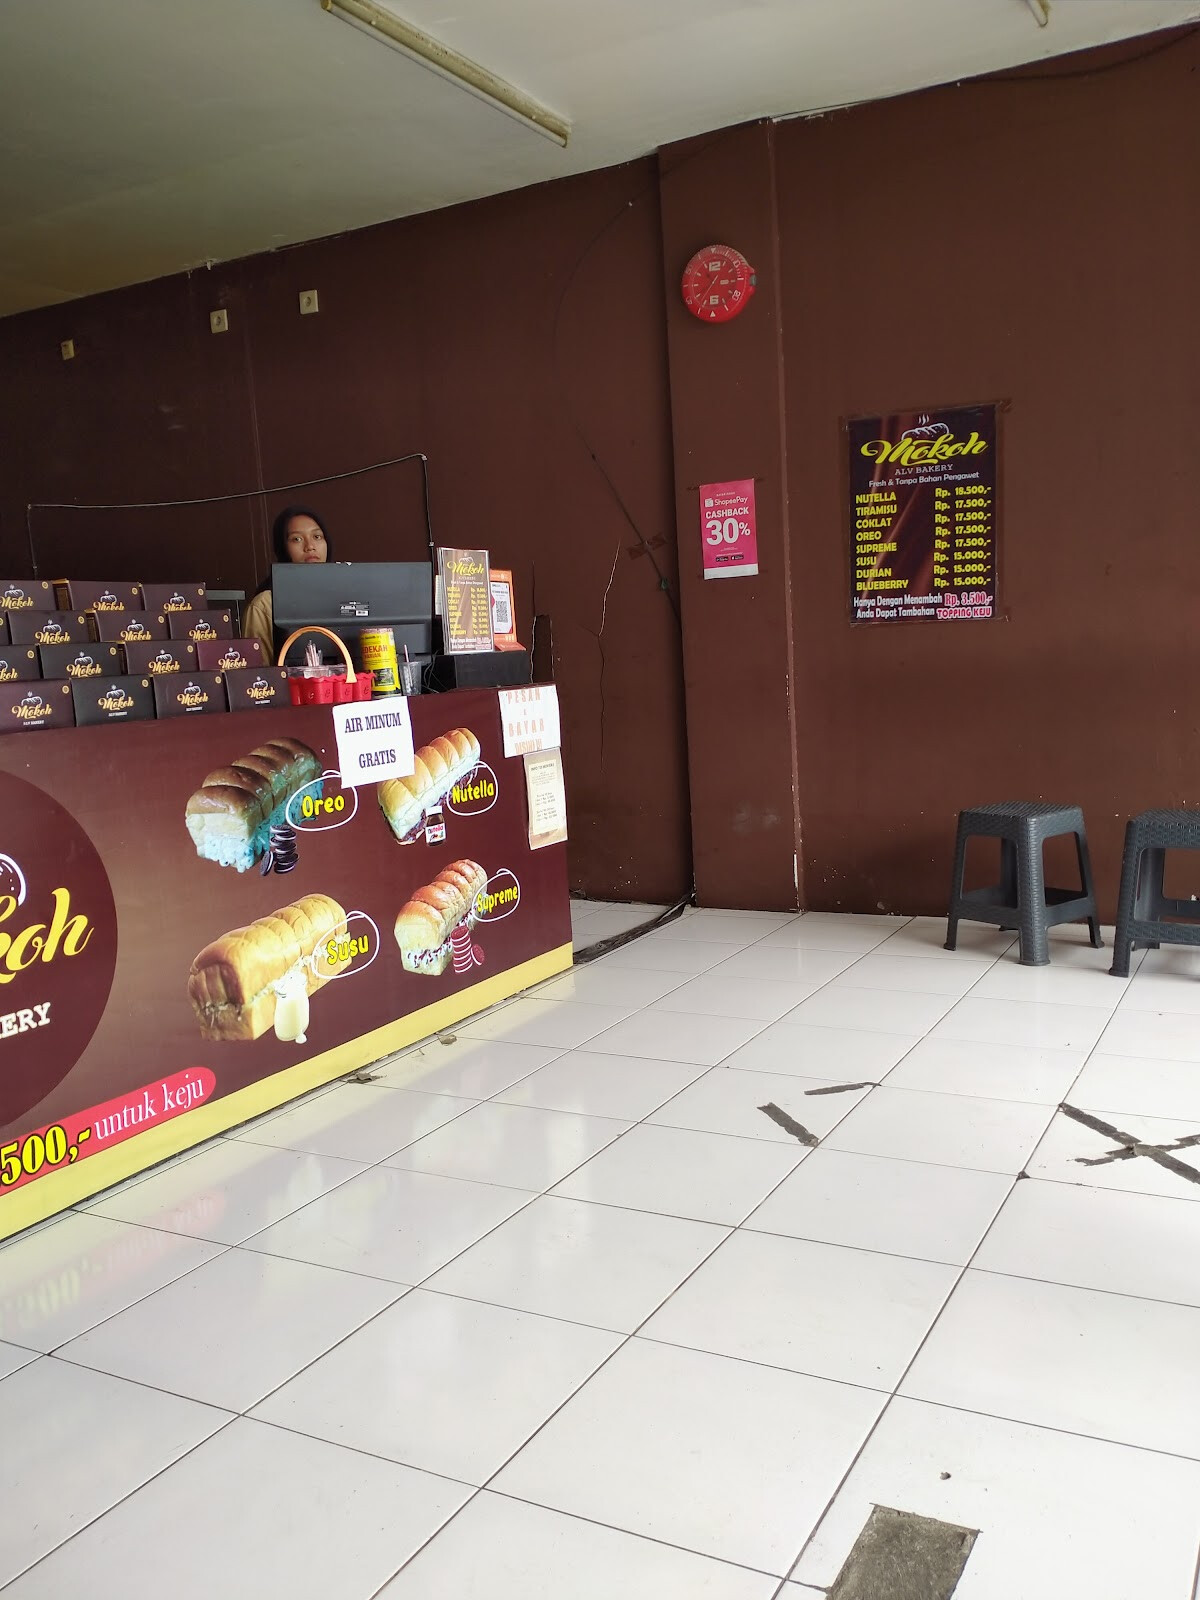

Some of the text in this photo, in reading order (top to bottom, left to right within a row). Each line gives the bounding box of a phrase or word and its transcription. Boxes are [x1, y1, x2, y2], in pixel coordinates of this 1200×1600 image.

[860, 432, 988, 466] Mokoh
[895, 464, 953, 475] ALV BAKERY
[869, 472, 980, 488] Fresh & Tanpa Bahan Pengawet
[714, 496, 748, 506] ShopeePay
[855, 485, 992, 504] NUTELLA Rp. 18.500,-
[705, 507, 749, 519] CASHBACK
[855, 498, 992, 517] TIRAMISU Rp. 17.500,-
[856, 511, 992, 529] COKLAT Rp. 17.500,-
[705, 518, 751, 545] 30%
[856, 524, 992, 541] OREO Rp. 17.500,-
[856, 537, 992, 554] SUPREME Rp. 17.500,-
[856, 550, 992, 566] SUSU Rp. 15.000,-
[856, 563, 992, 578] DURIAN Rp. 15.000,-
[856, 576, 992, 591] BLUEBERRY Rp. 15.000,-
[854, 592, 993, 608] Hanya Dengan Menambah Rp. 3.500,-
[856, 606, 992, 619] Anda Dapat Tambahan TOPPING KEJU
[66, 664, 102, 677] Mokoh
[98, 697, 134, 711] Mokoh
[507, 688, 541, 704] PESAN
[12, 703, 52, 719] Mokoh
[345, 712, 402, 733] AIR MINUM
[508, 718, 544, 737] BAYAR
[358, 749, 397, 769] GRATIS
[451, 780, 494, 804] Nutella
[302, 795, 345, 818] Oreo
[477, 885, 518, 913] Supreme
[326, 935, 369, 966] Susu
[0, 1002, 51, 1039] ERY
[94, 1091, 157, 1140] untuk
[162, 1073, 205, 1109] keju
